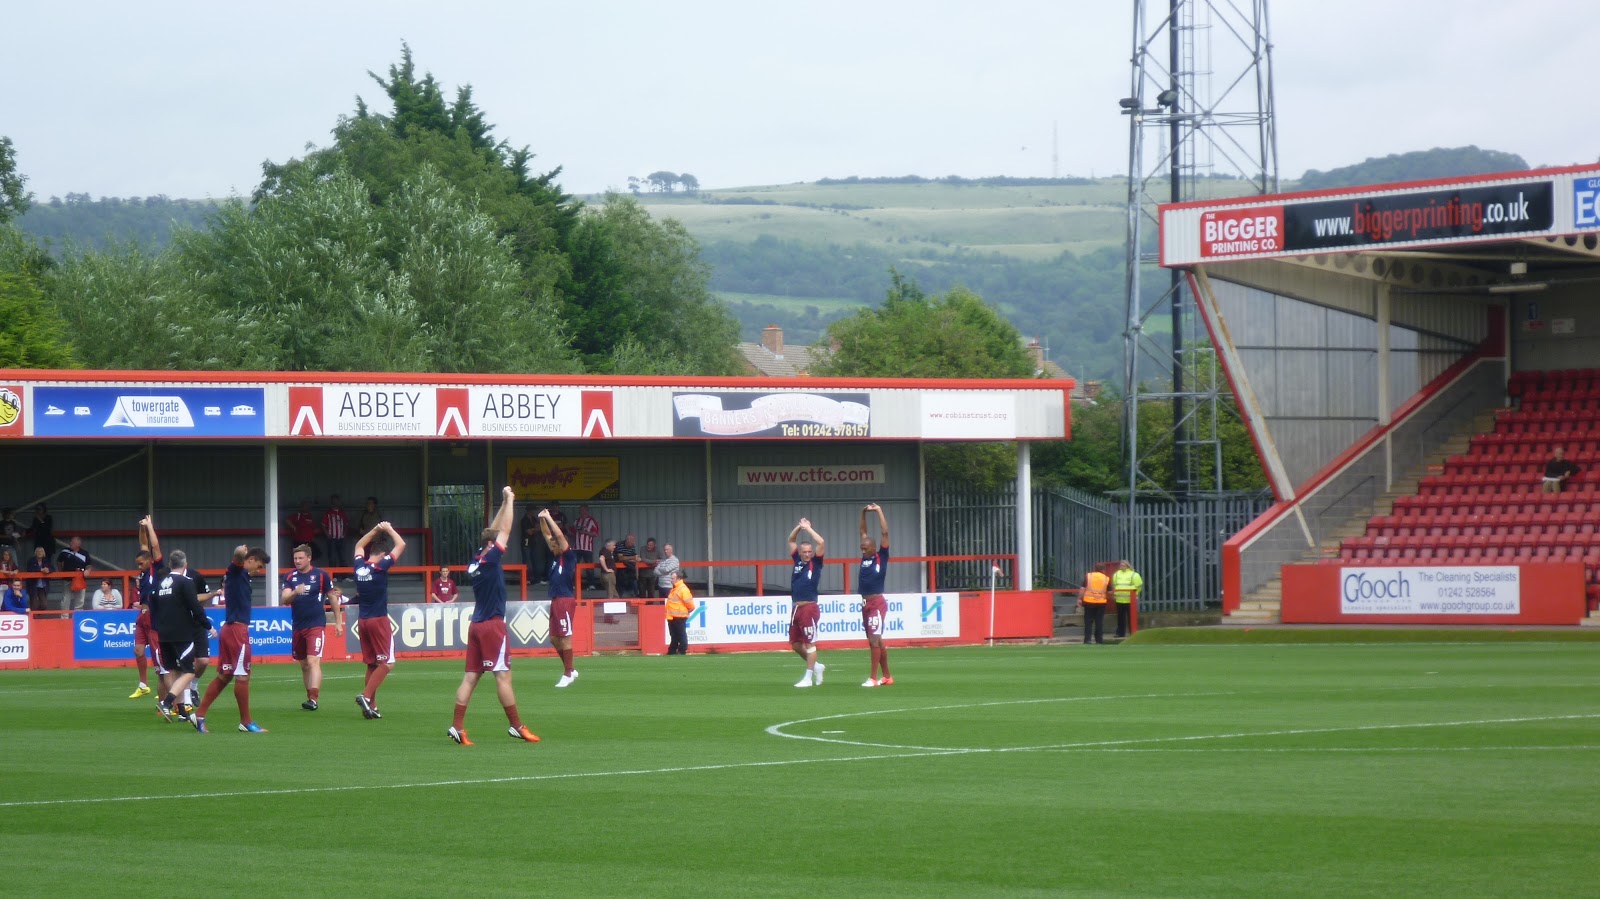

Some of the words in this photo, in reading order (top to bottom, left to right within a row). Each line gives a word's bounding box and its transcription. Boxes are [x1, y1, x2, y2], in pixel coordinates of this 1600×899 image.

[1315, 191, 1530, 240] www.biggerprinting.co.uk
[1206, 216, 1279, 242] BIGGER
[1212, 240, 1259, 254] PRINTING
[1261, 238, 1278, 250] CO.
[132, 399, 180, 415] towergate
[339, 391, 421, 418] ABBEY
[482, 393, 561, 419] ABBEY
[147, 414, 180, 424] insurance
[704, 412, 757, 425] BANNERS
[929, 412, 1007, 420] www.robinstrust.org
[339, 422, 375, 431] BUSINESS
[377, 422, 421, 431] EQUIPMENT
[482, 423, 518, 432] BUSINESS
[520, 423, 562, 433] EQUIPMENT
[781, 424, 800, 437] Tel:
[802, 423, 832, 437] 01242
[746, 467, 875, 483] www.ctfc.com
[1419, 572, 1434, 582] The
[1436, 571, 1471, 584] Cleaning
[1473, 571, 1517, 584] Specialists
[1344, 571, 1411, 603] Gooch
[1438, 588, 1463, 598] 01242
[1465, 588, 1496, 598] 528564
[726, 602, 773, 615] Leaders
[776, 602, 787, 614] in
[1420, 601, 1516, 612] www.goochgroup.co.uk
[401, 606, 474, 647] erre
